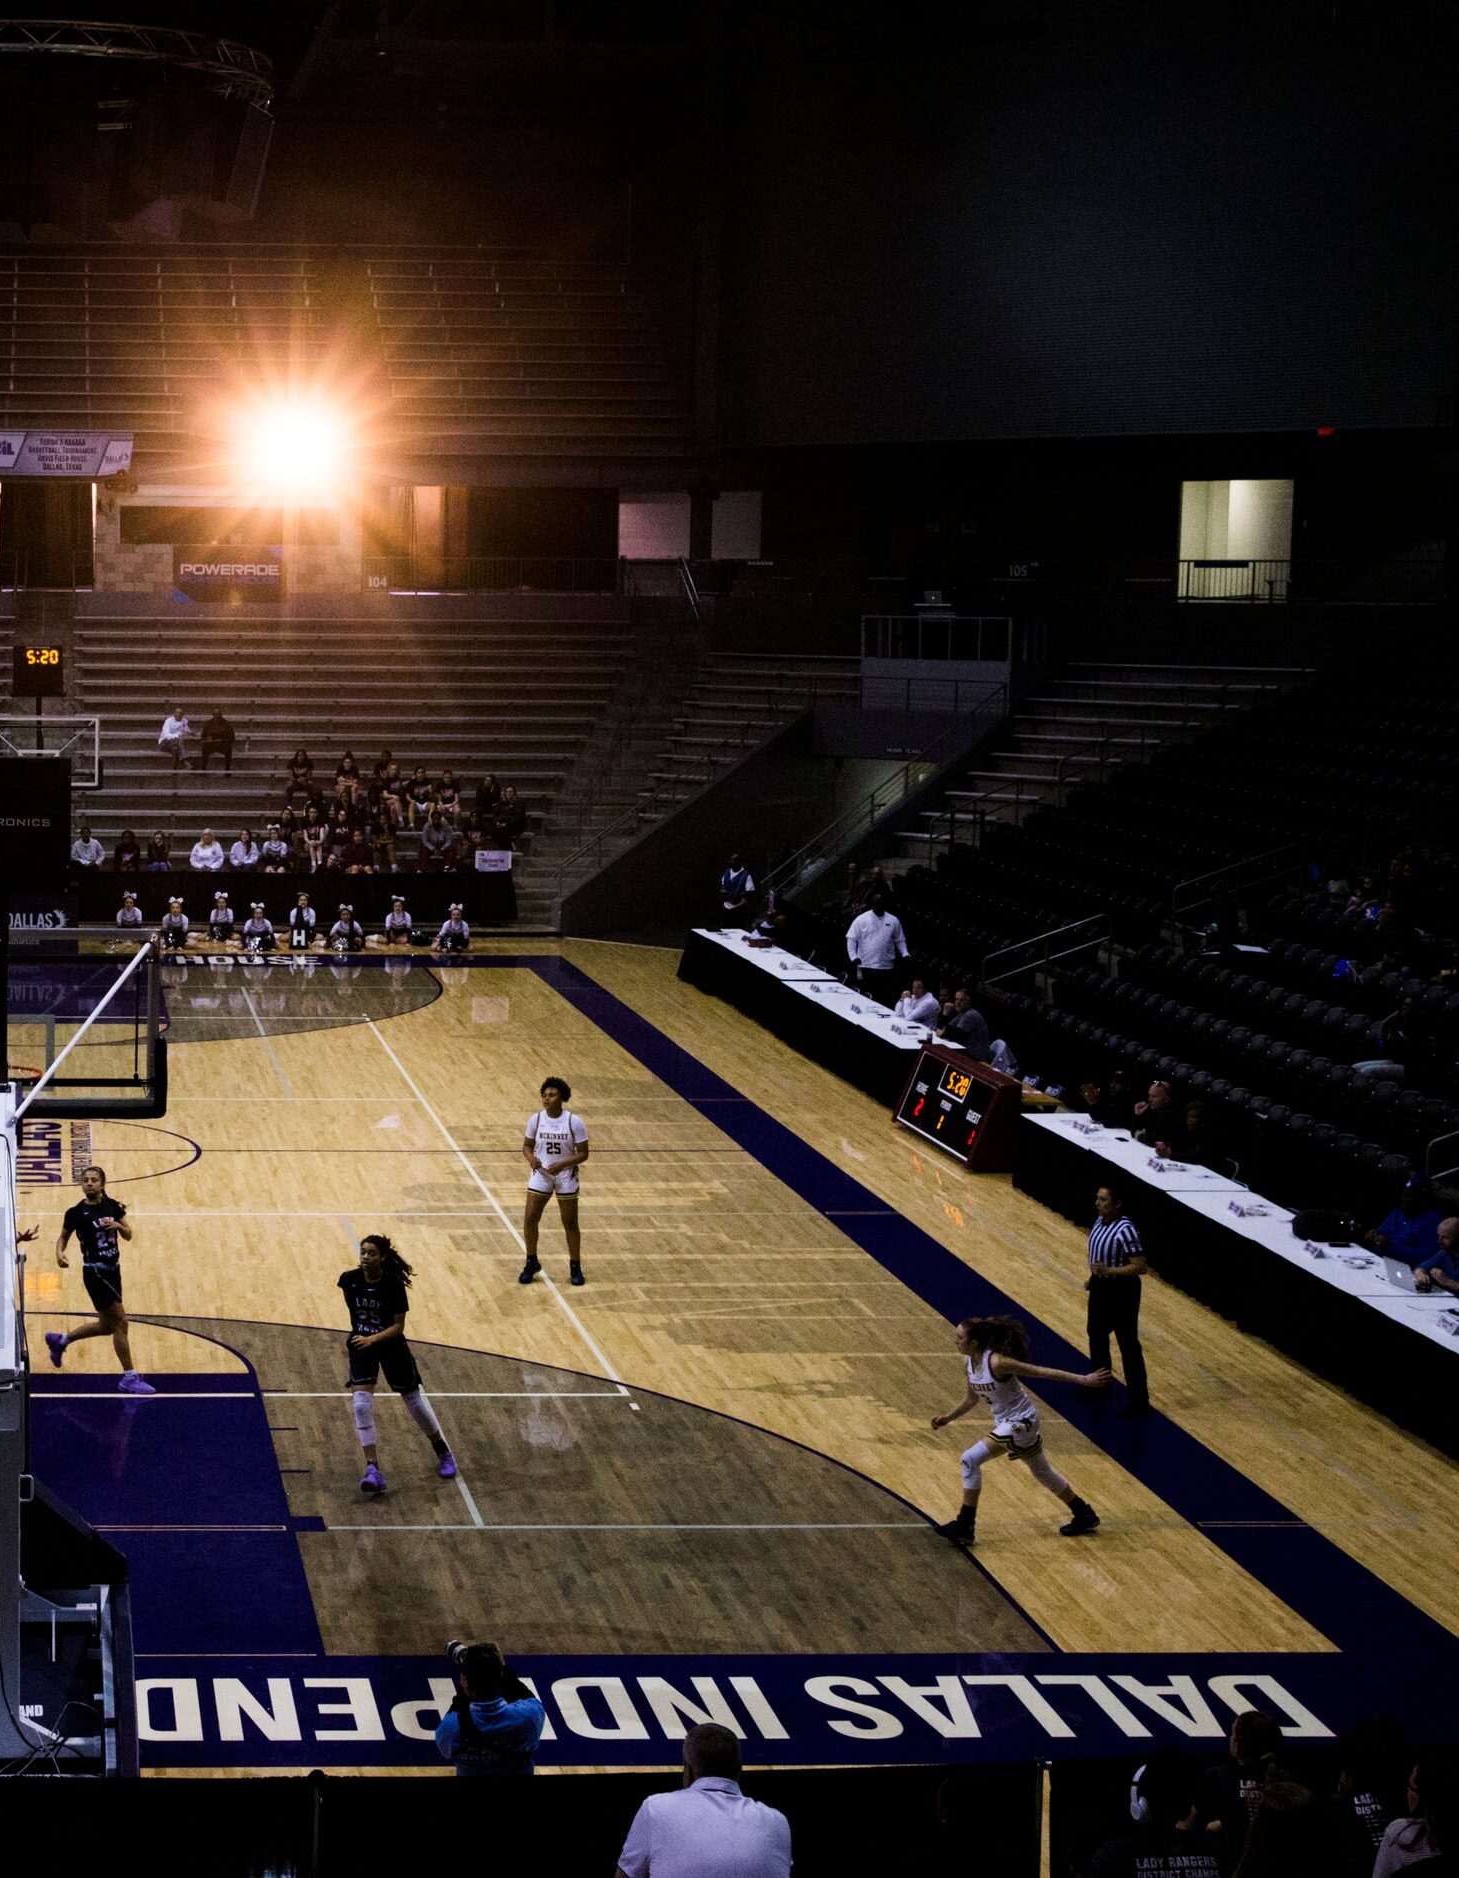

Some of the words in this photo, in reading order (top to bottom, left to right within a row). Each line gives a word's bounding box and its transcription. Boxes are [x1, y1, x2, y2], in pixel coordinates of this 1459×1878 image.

[180, 564, 280, 576] POWERADE
[1009, 565, 1028, 577] 105
[369, 576, 388, 588] 104
[26, 649, 59, 665] 5:20
[292, 929, 306, 947] H
[175, 955, 323, 965] HOUSE
[946, 1071, 971, 1097] 5:20
[913, 1098, 925, 1116] 2
[936, 1114, 945, 1131] 1
[539, 1131, 568, 1141] MCKINNEY
[546, 1141, 561, 1155] 25
[355, 1297, 382, 1309] LADY
[804, 1673, 1337, 1738] DALLAS
[1135, 1857, 1165, 1870] LADY
[1167, 1855, 1218, 1869] RANGERS
